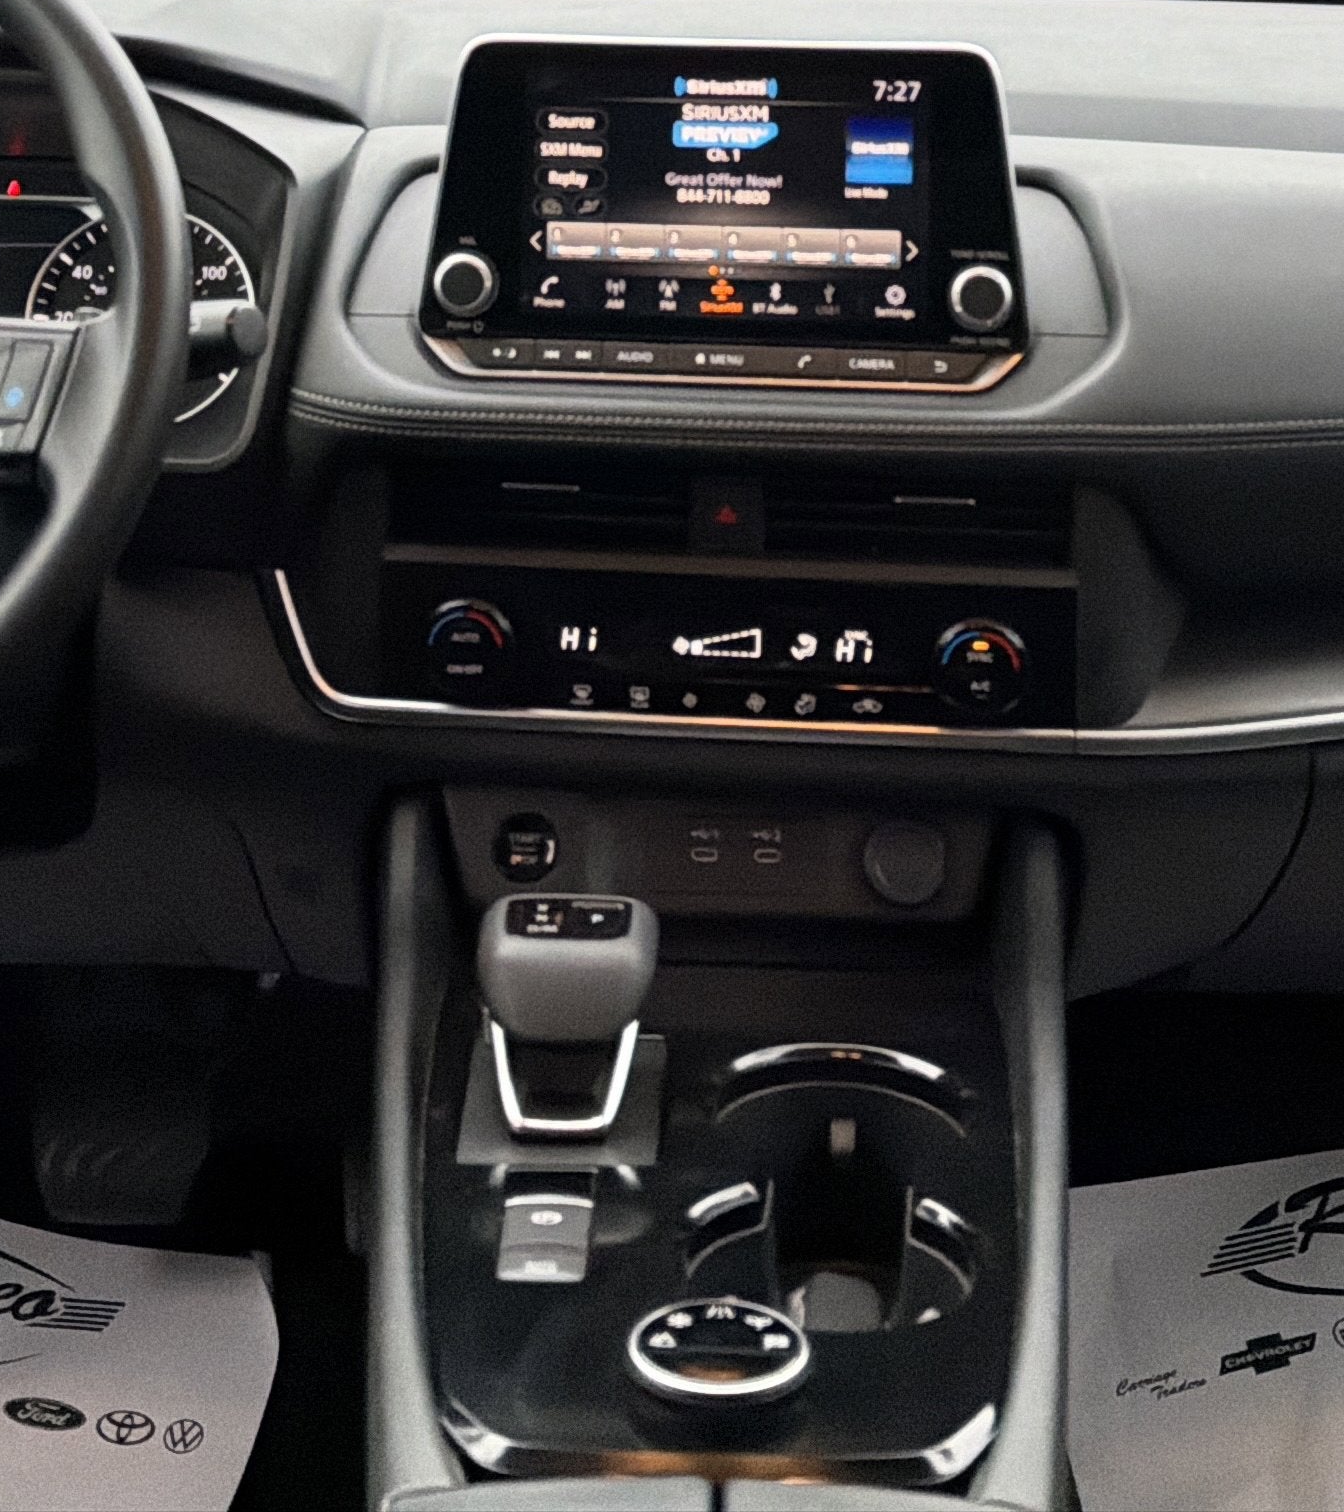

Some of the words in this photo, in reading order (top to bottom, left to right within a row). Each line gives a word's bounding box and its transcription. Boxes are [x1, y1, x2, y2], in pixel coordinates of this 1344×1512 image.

[872, 80, 922, 102] 7:27
[71, 265, 93, 280] 40
[201, 265, 228, 280] 100
[16, 1394, 74, 1429] Ford
